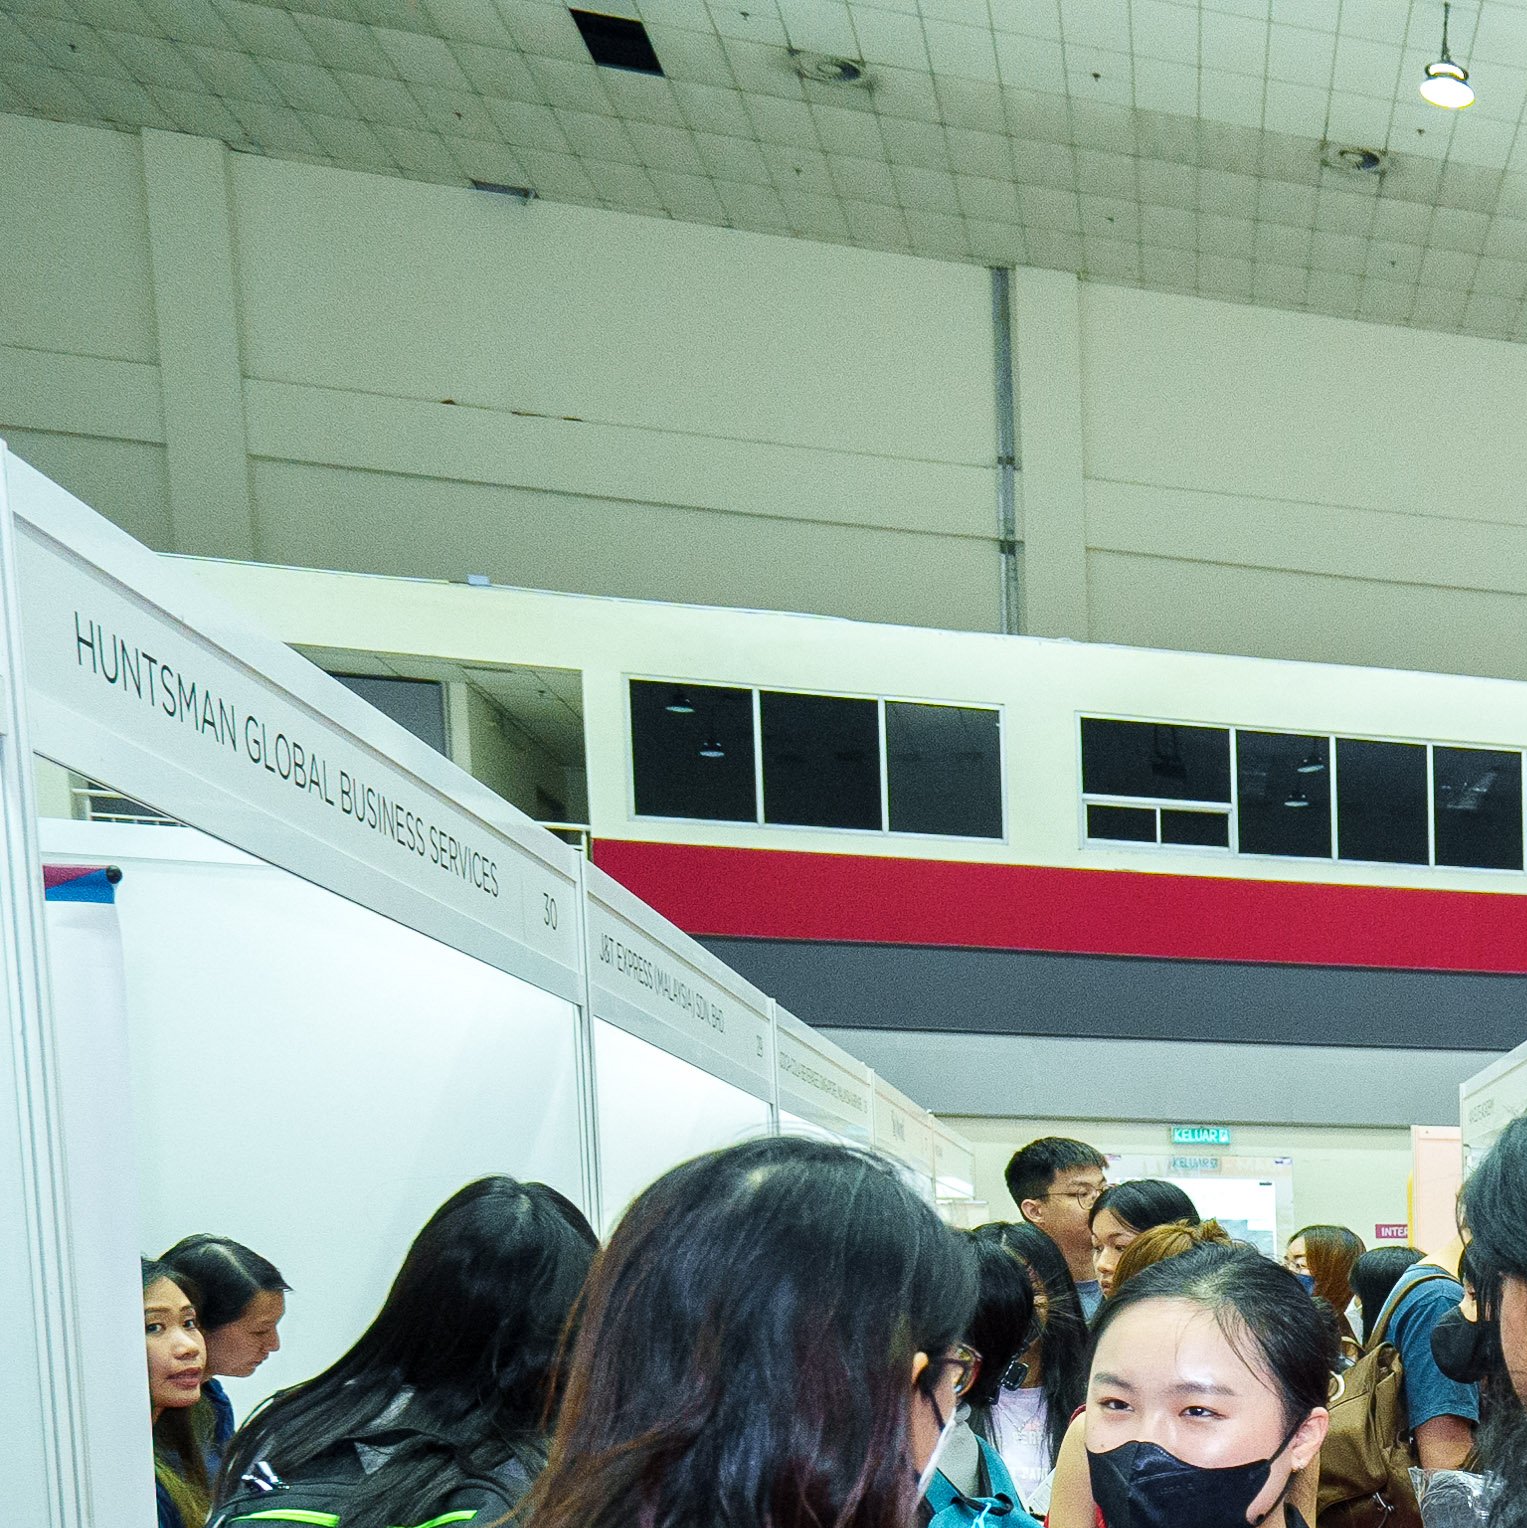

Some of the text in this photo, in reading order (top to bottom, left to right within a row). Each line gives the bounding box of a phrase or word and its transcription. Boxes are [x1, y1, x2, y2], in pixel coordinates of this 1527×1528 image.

[74, 610, 500, 899] HUNTSMAN GLOBAL BUSINESS SERVICES
[543, 893, 559, 932] 30
[617, 943, 654, 989] EXPRESS
[1174, 1127, 1217, 1143] KELUAR
